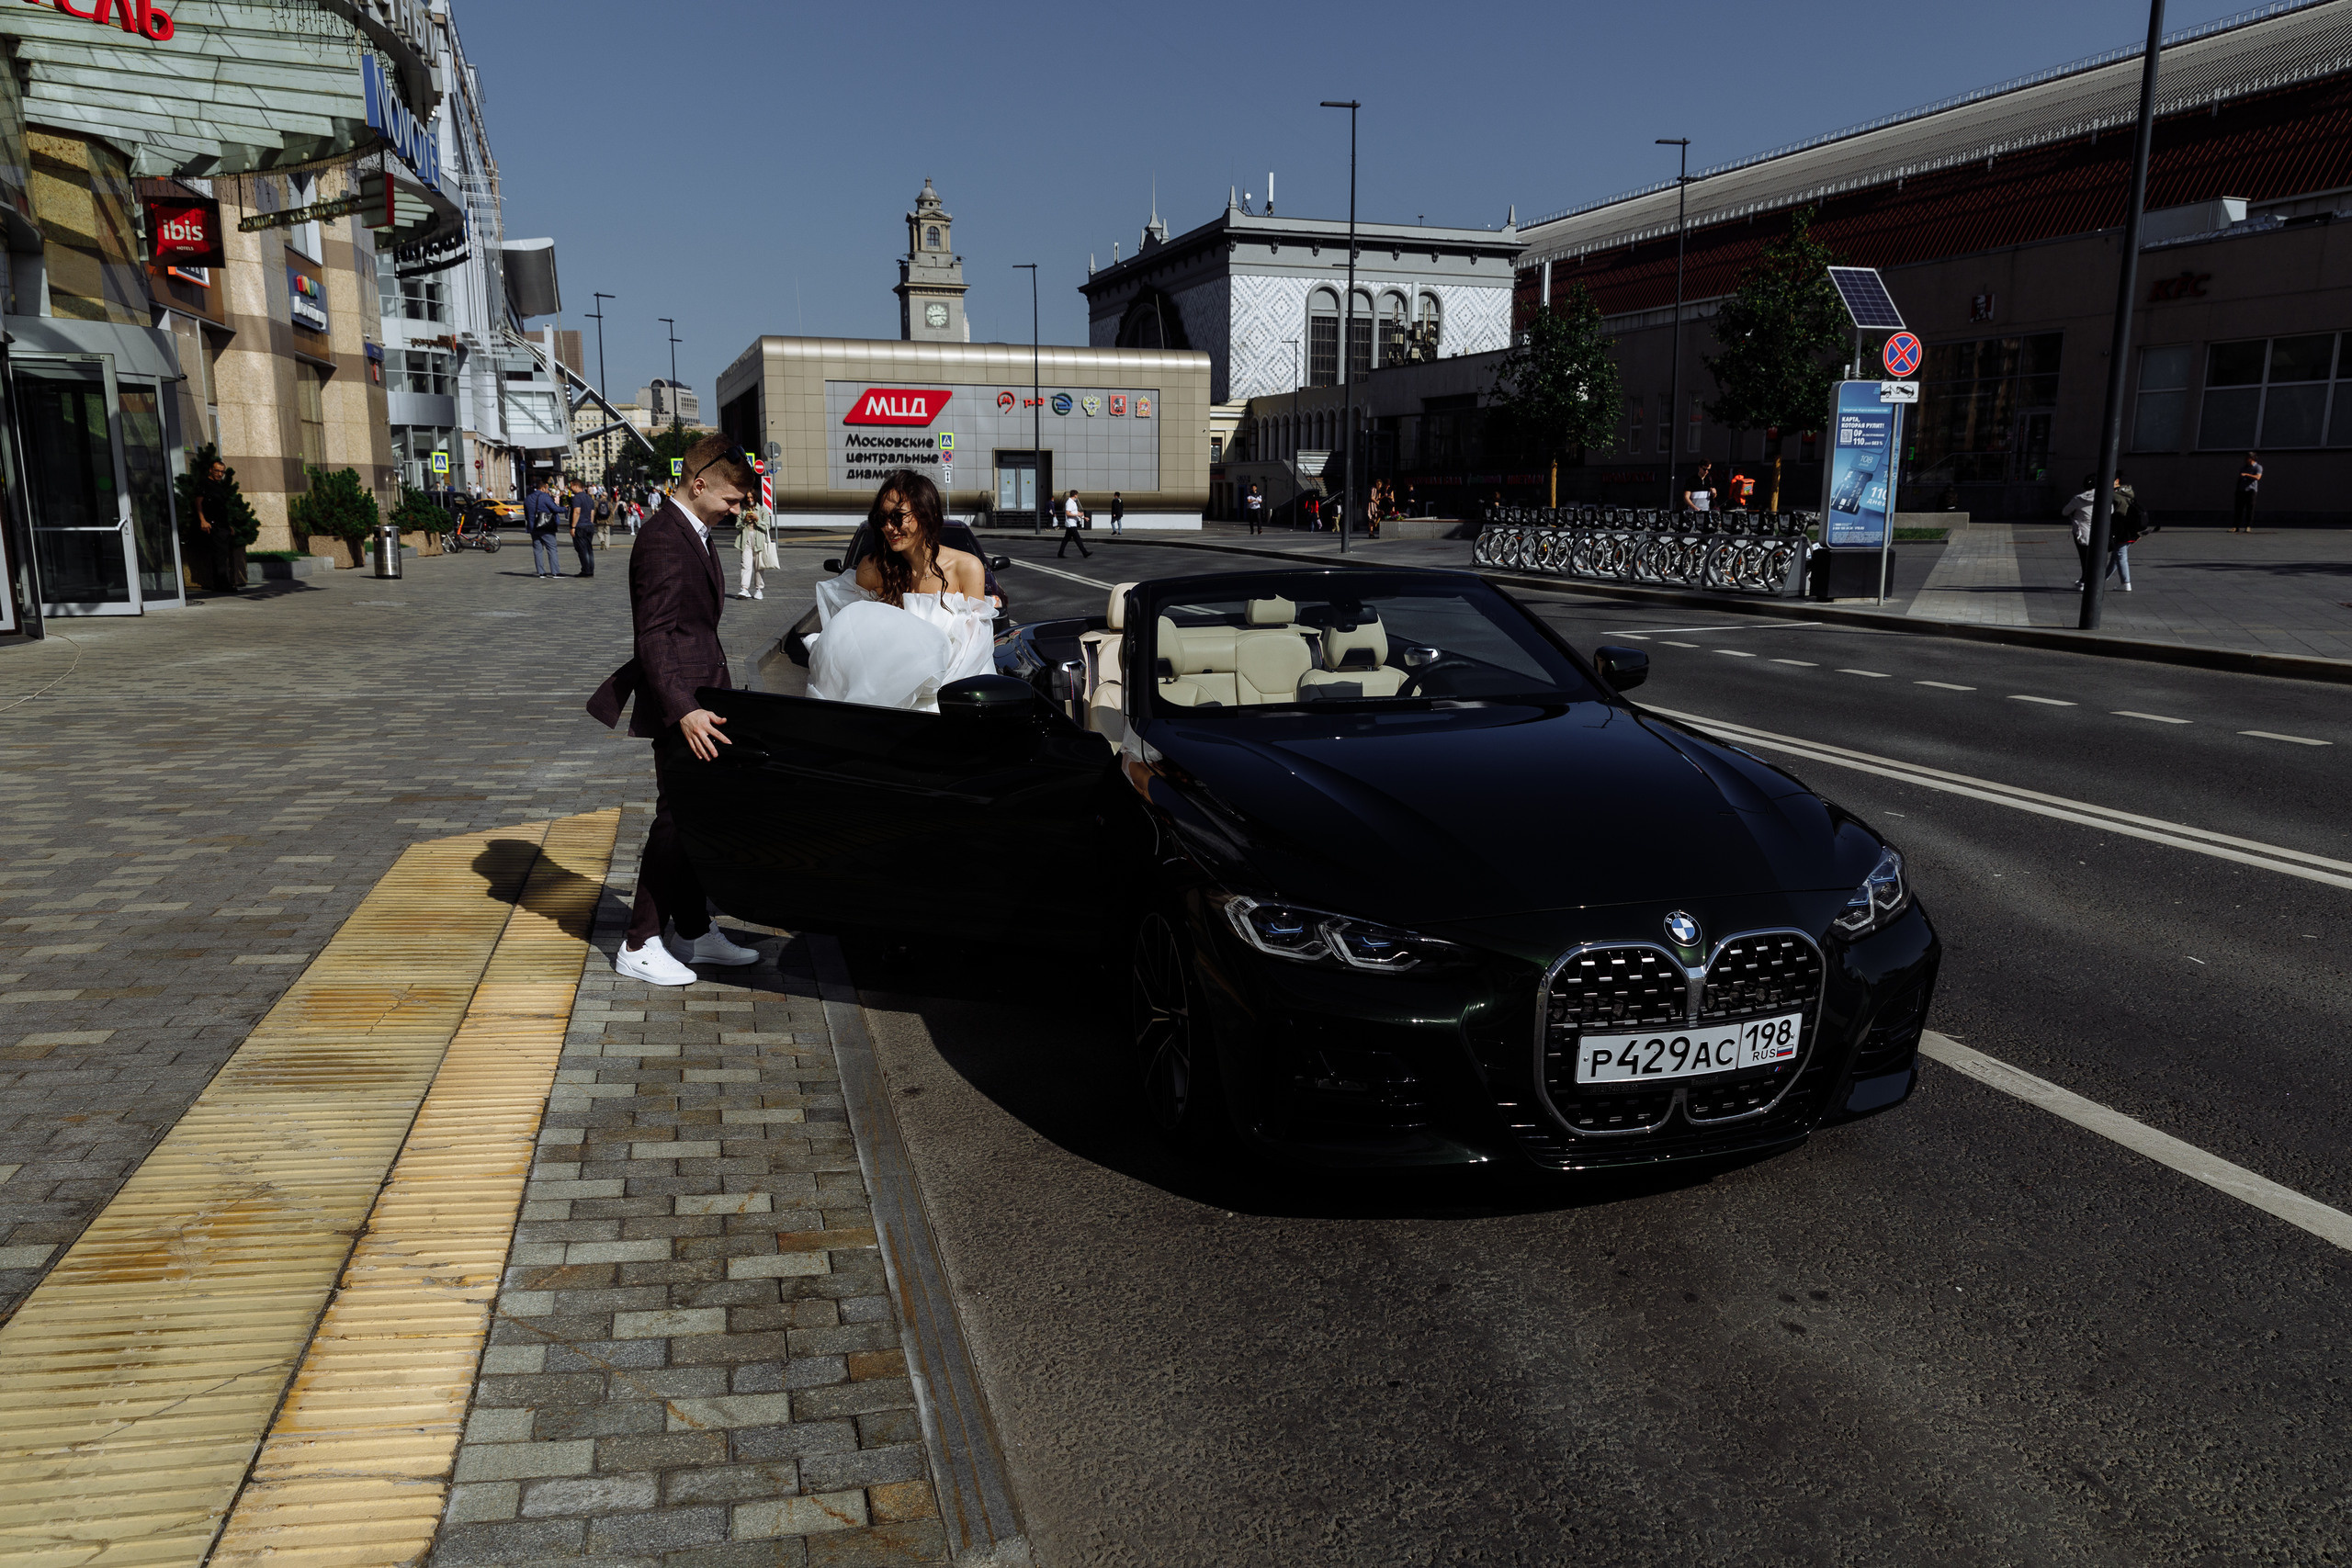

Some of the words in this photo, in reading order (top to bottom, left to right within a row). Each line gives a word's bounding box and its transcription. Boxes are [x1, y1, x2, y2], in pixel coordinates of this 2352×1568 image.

[163, 220, 204, 242] ibis
[2147, 273, 2211, 302] KFC
[865, 396, 928, 417] МЦД
[845, 434, 934, 448] Московские
[1853, 437, 1865, 446] 110
[846, 452, 940, 466] центральные
[1860, 455, 1873, 464] 108
[1590, 1036, 1736, 1077] Р429АС
[1746, 1019, 1792, 1051] 198
[1752, 1048, 1777, 1062] RUS
